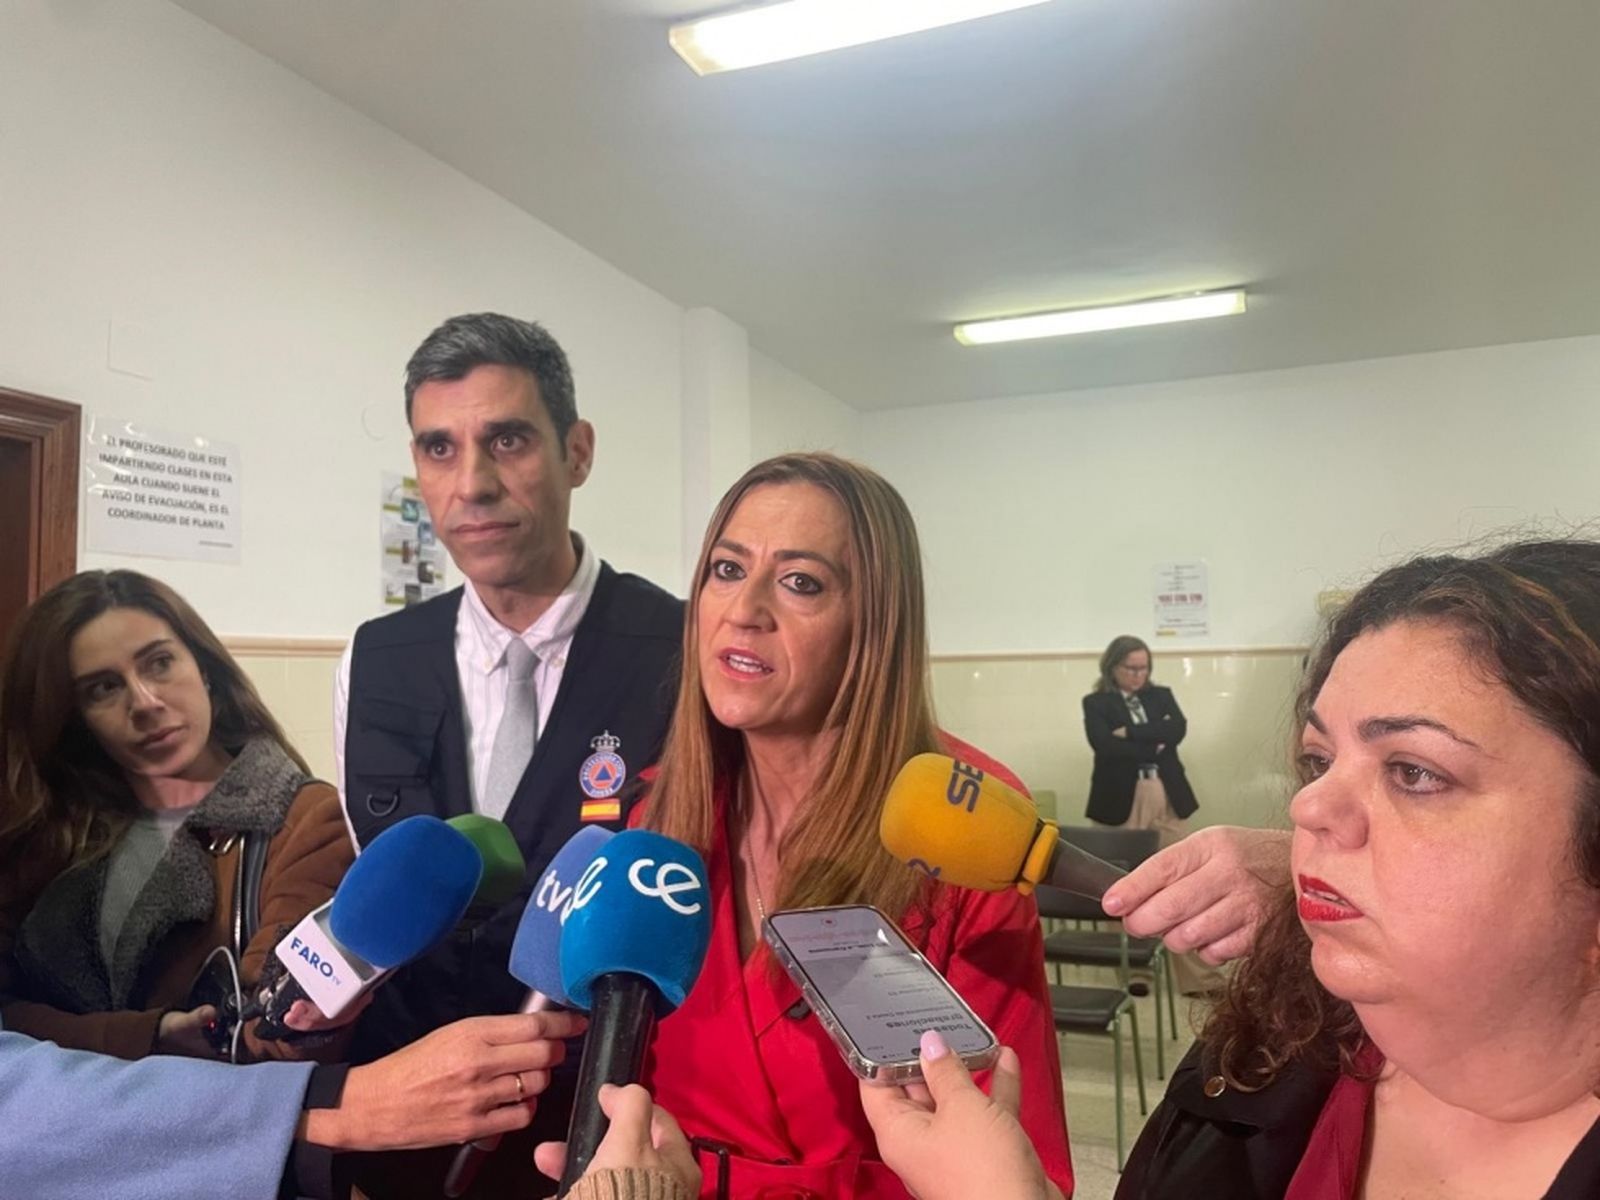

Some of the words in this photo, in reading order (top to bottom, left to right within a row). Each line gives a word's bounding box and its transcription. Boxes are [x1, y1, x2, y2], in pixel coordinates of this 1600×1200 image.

[119, 438, 186, 459] PROFESORADO
[188, 451, 205, 463] QUE
[99, 453, 165, 472] IMPARTIENDO
[167, 464, 197, 478] CLASES
[199, 470, 211, 479] EN
[212, 472, 232, 483] ESTA
[113, 473, 139, 485] AULA
[141, 477, 180, 492] CUANDO
[211, 488, 220, 497] EL
[102, 489, 132, 502] AVISO
[134, 494, 146, 504] DE
[209, 504, 219, 513] ES
[220, 505, 229, 515] EL
[107, 507, 177, 524] COORDINADOR
[179, 515, 190, 526] DE
[192, 517, 224, 529] PLANTA
[290, 937, 333, 978] FARO
